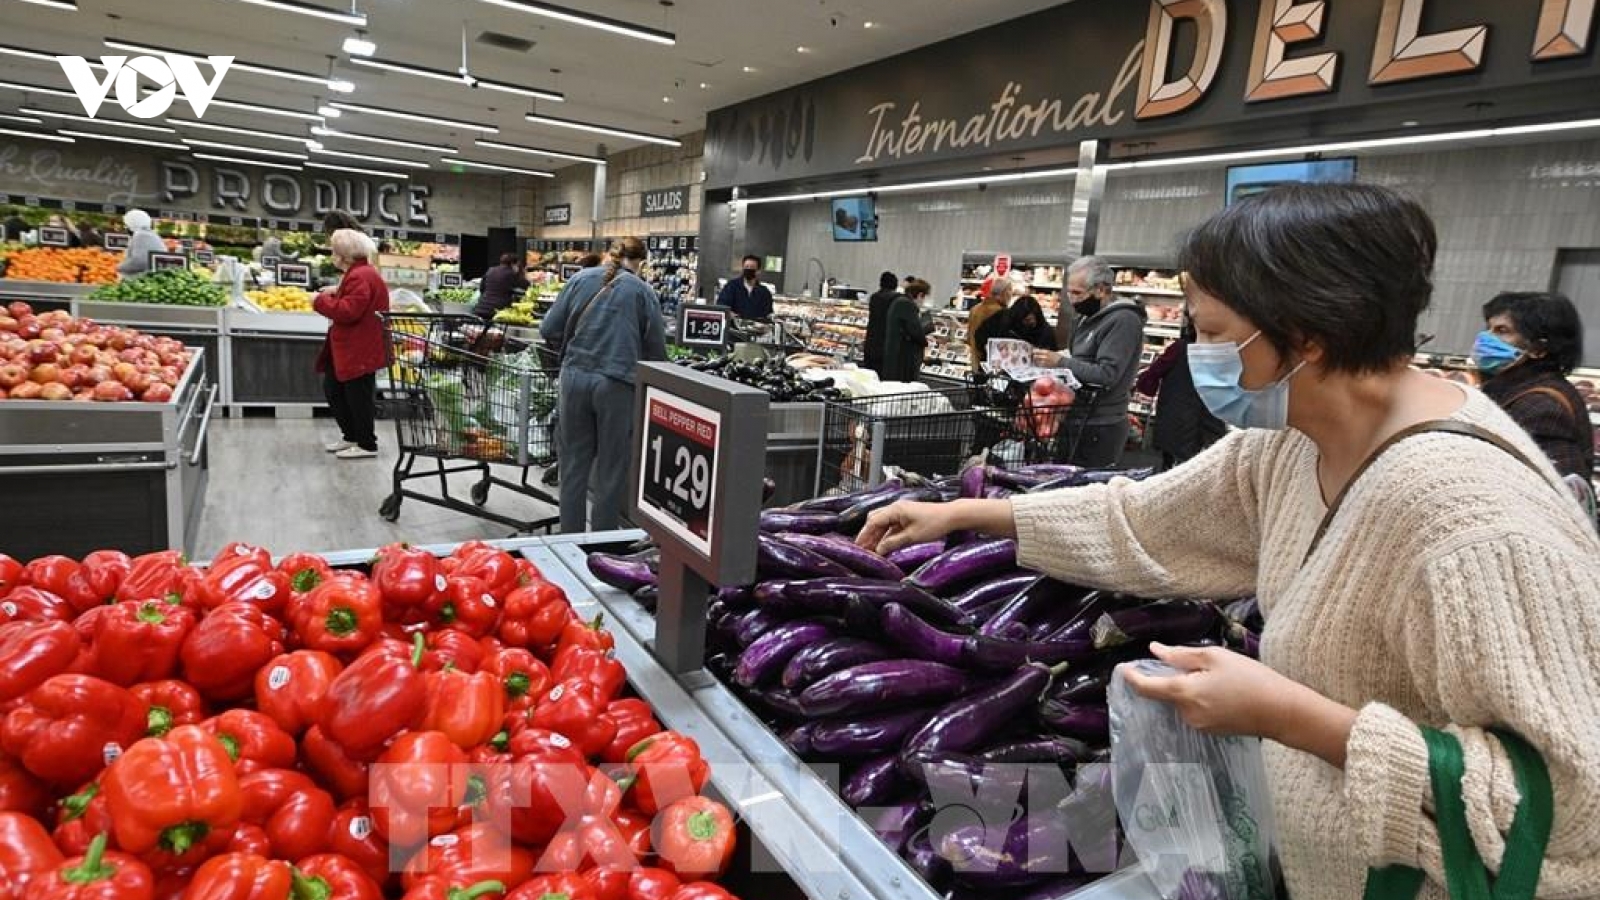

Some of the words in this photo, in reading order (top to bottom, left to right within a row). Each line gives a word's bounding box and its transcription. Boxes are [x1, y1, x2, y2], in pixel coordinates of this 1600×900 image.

[855, 39, 1145, 164] International
[25, 149, 158, 203] Quality
[162, 161, 431, 226] PRODUCE
[645, 191, 682, 212] SALADS
[688, 319, 720, 336] 1.29
[652, 404, 668, 420] BELL
[669, 412, 696, 432] PEPPER
[696, 421, 713, 440] RED
[651, 435, 709, 509] 1.29
